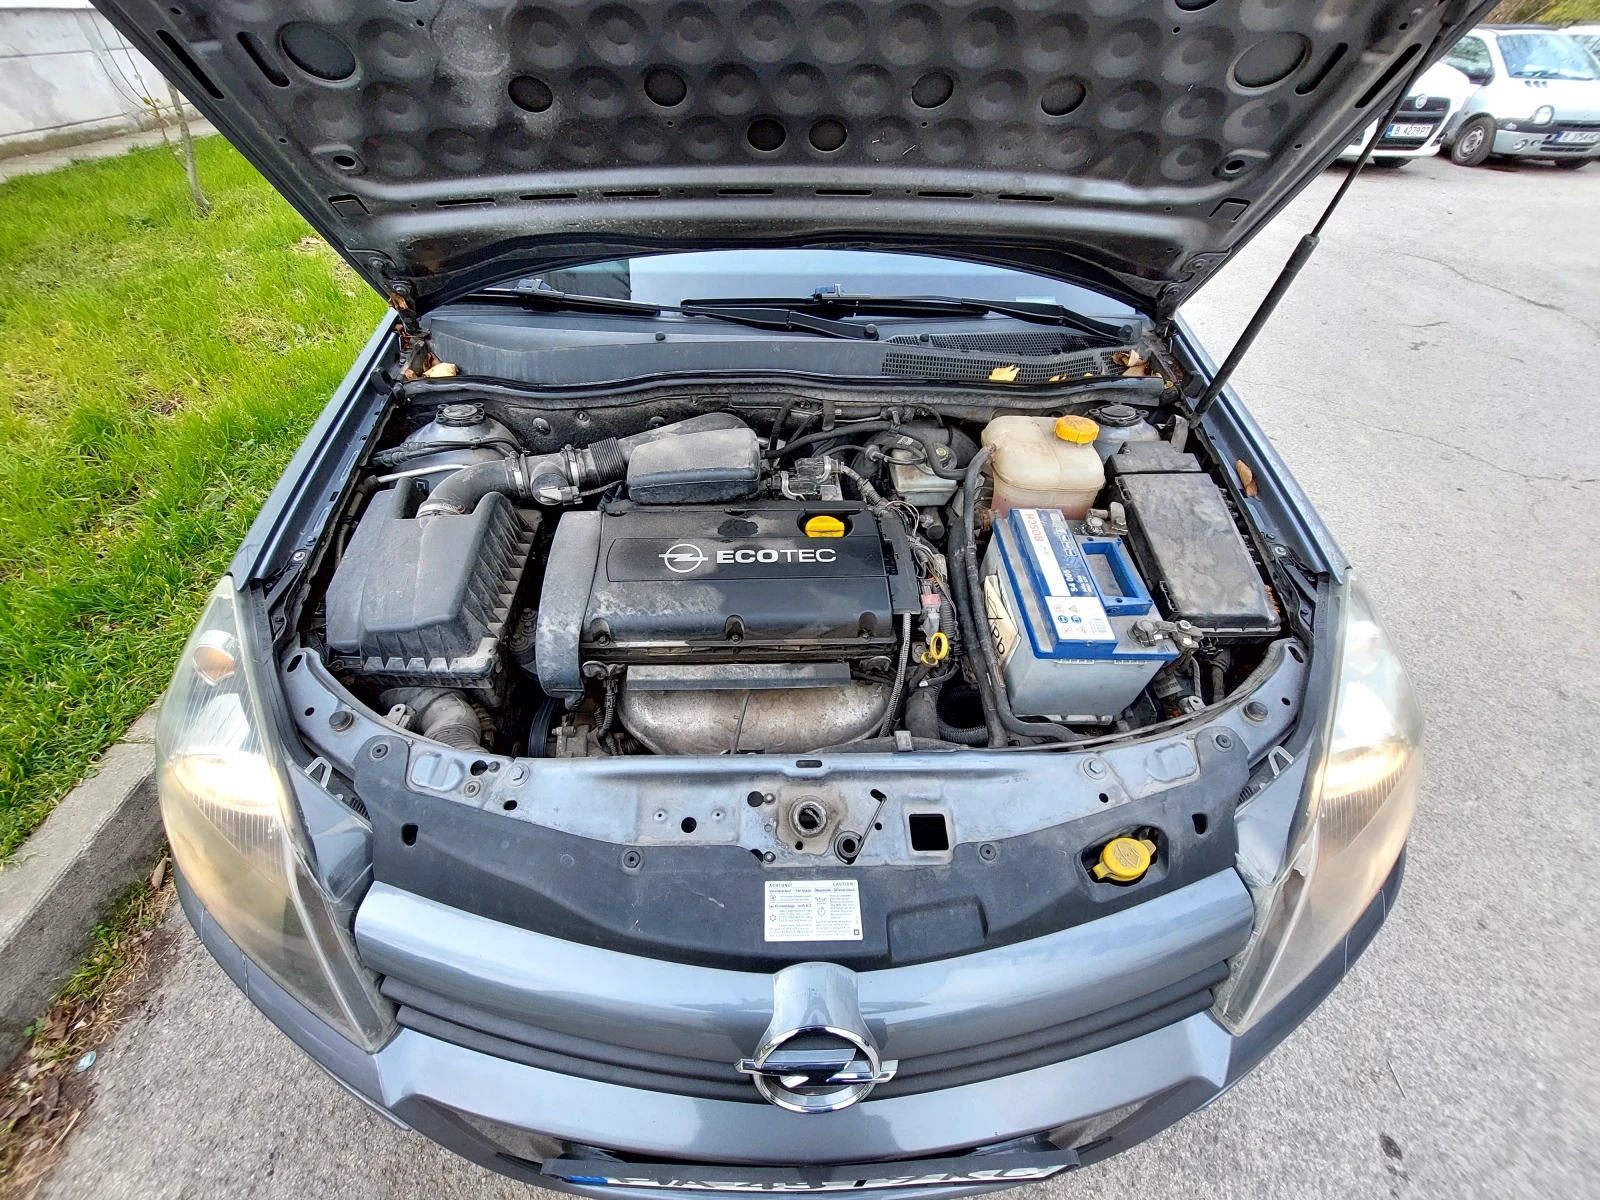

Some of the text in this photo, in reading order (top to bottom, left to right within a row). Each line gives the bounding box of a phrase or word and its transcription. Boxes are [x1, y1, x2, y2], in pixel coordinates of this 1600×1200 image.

[1394, 126, 1401, 135] B
[1025, 513, 1044, 542] BOSCH
[716, 548, 837, 564] ECOTEC
[1063, 569, 1079, 592] S4 005
[991, 626, 1005, 655] Pb
